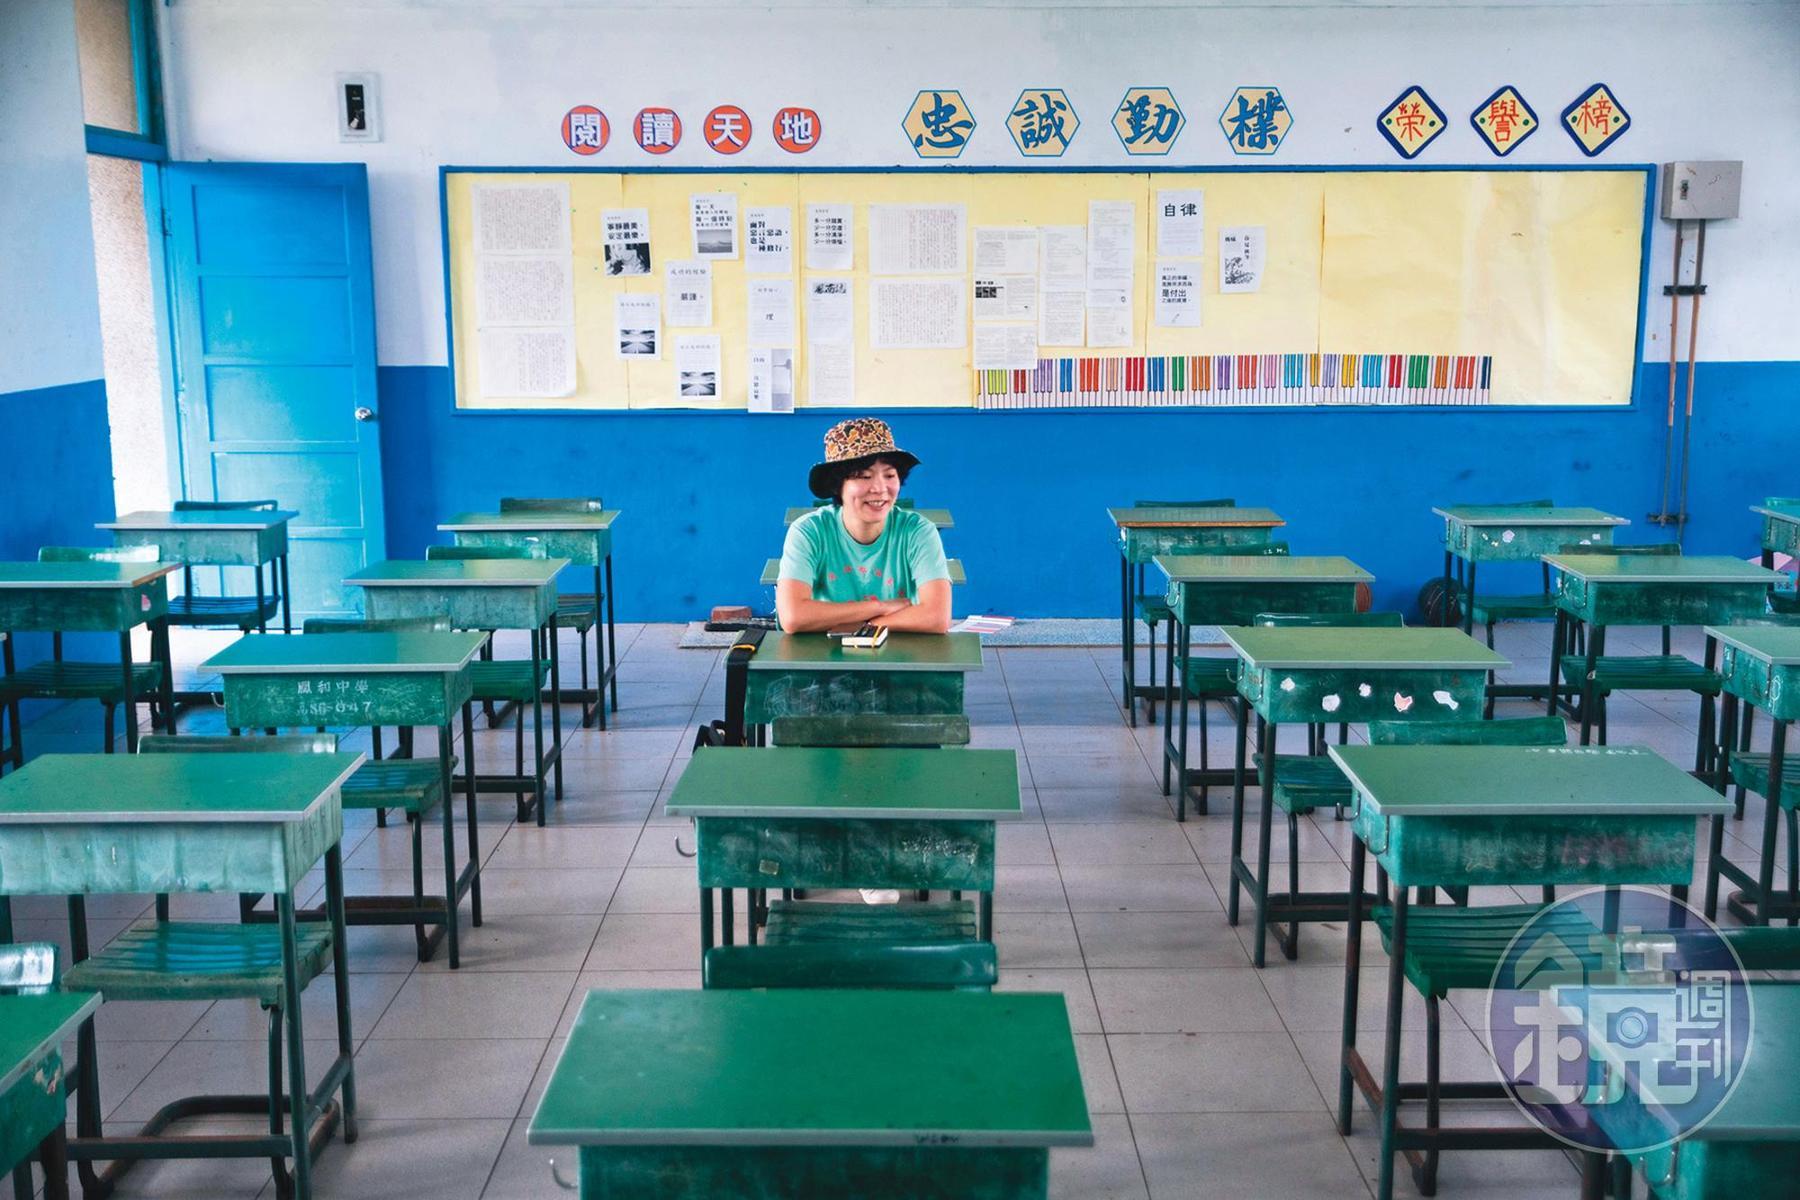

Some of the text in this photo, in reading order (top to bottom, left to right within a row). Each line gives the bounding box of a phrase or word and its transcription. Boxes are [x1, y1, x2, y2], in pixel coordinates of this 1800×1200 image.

[569, 112, 813, 147] 閱讀天地
[914, 91, 1285, 150] 忠誠勤樸
[1395, 95, 1611, 143] 榮譽榜
[1164, 202, 1197, 218] 自律
